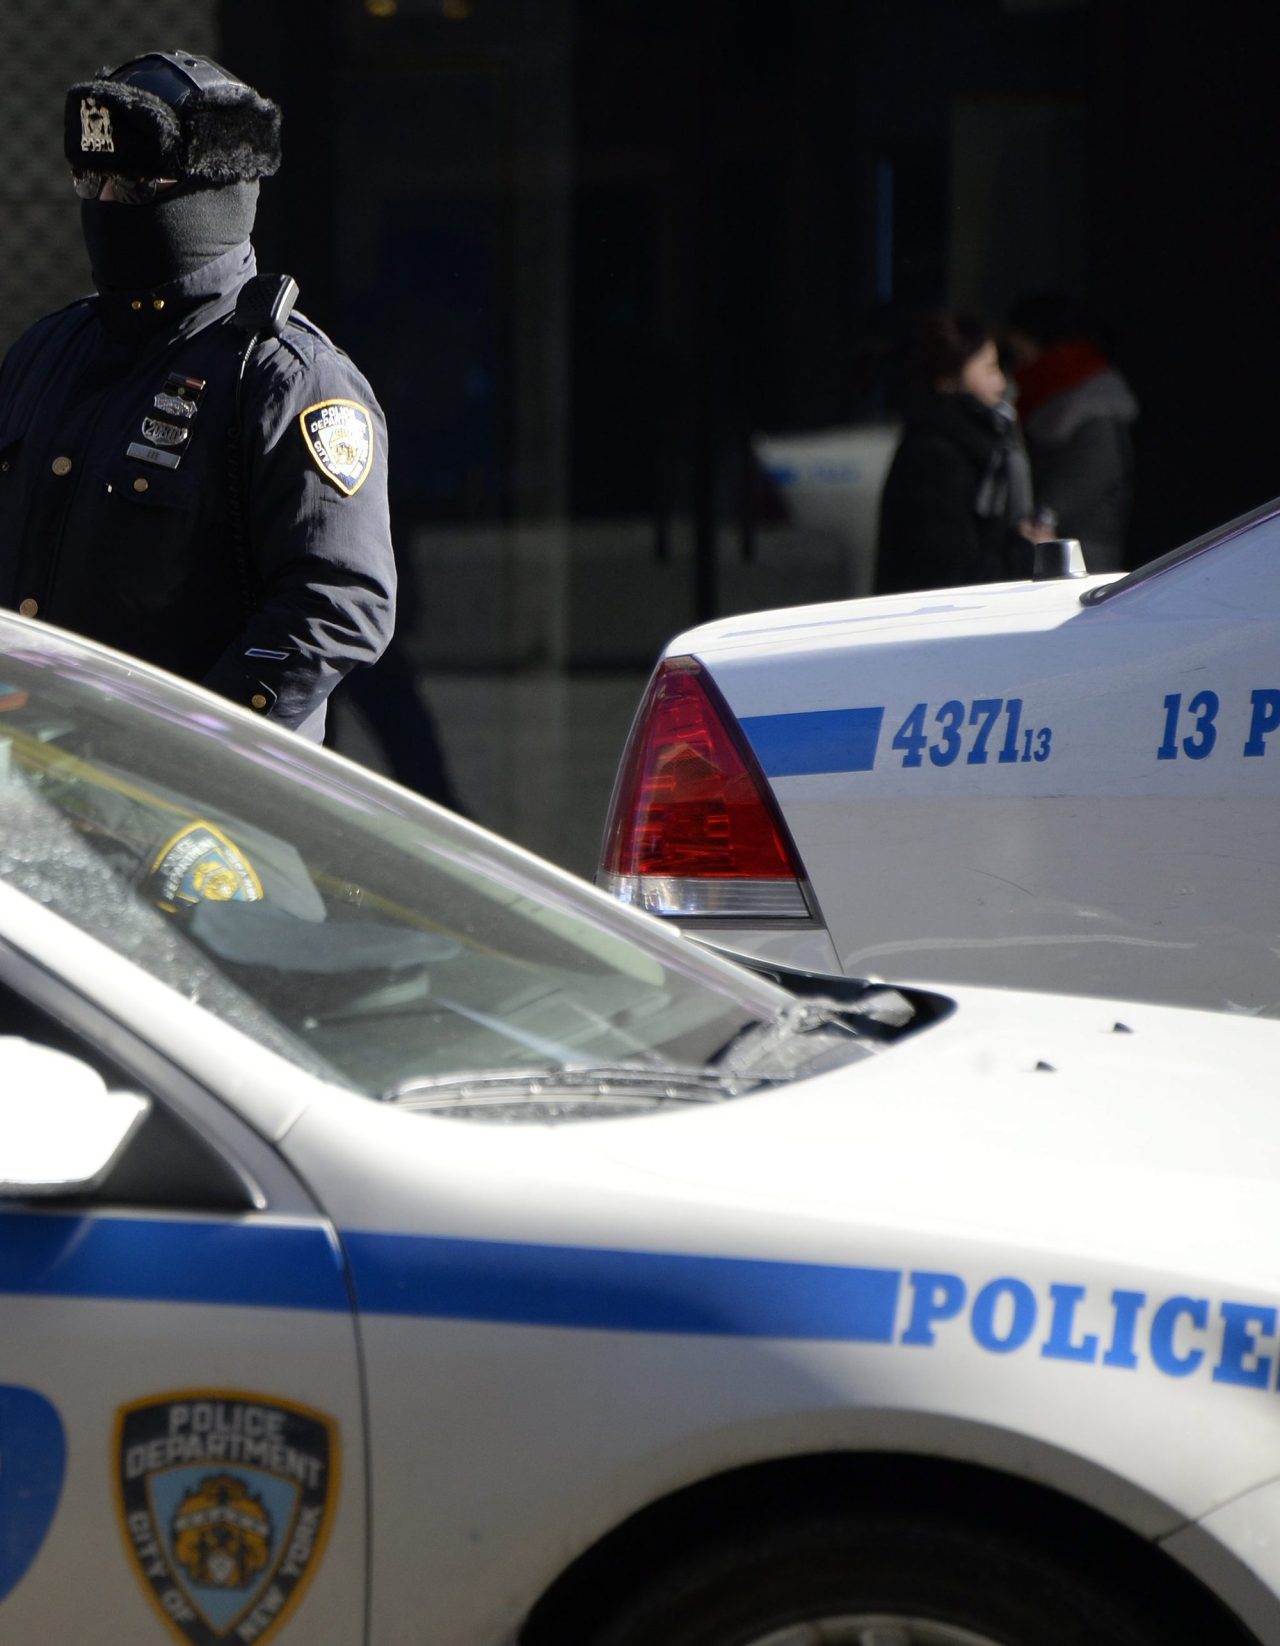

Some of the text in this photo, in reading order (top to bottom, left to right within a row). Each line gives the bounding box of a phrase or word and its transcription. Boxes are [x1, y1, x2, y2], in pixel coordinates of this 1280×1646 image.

[314, 440, 329, 462] CITY
[892, 698, 1053, 768] 4371 13
[1157, 690, 1220, 761] 13
[899, 1270, 1278, 1392] POLICE
[169, 1403, 287, 1440] POLICE
[126, 1433, 324, 1488] DEPARTMENT
[128, 1510, 198, 1623] CITY OF
[278, 1506, 324, 1577] YORK
